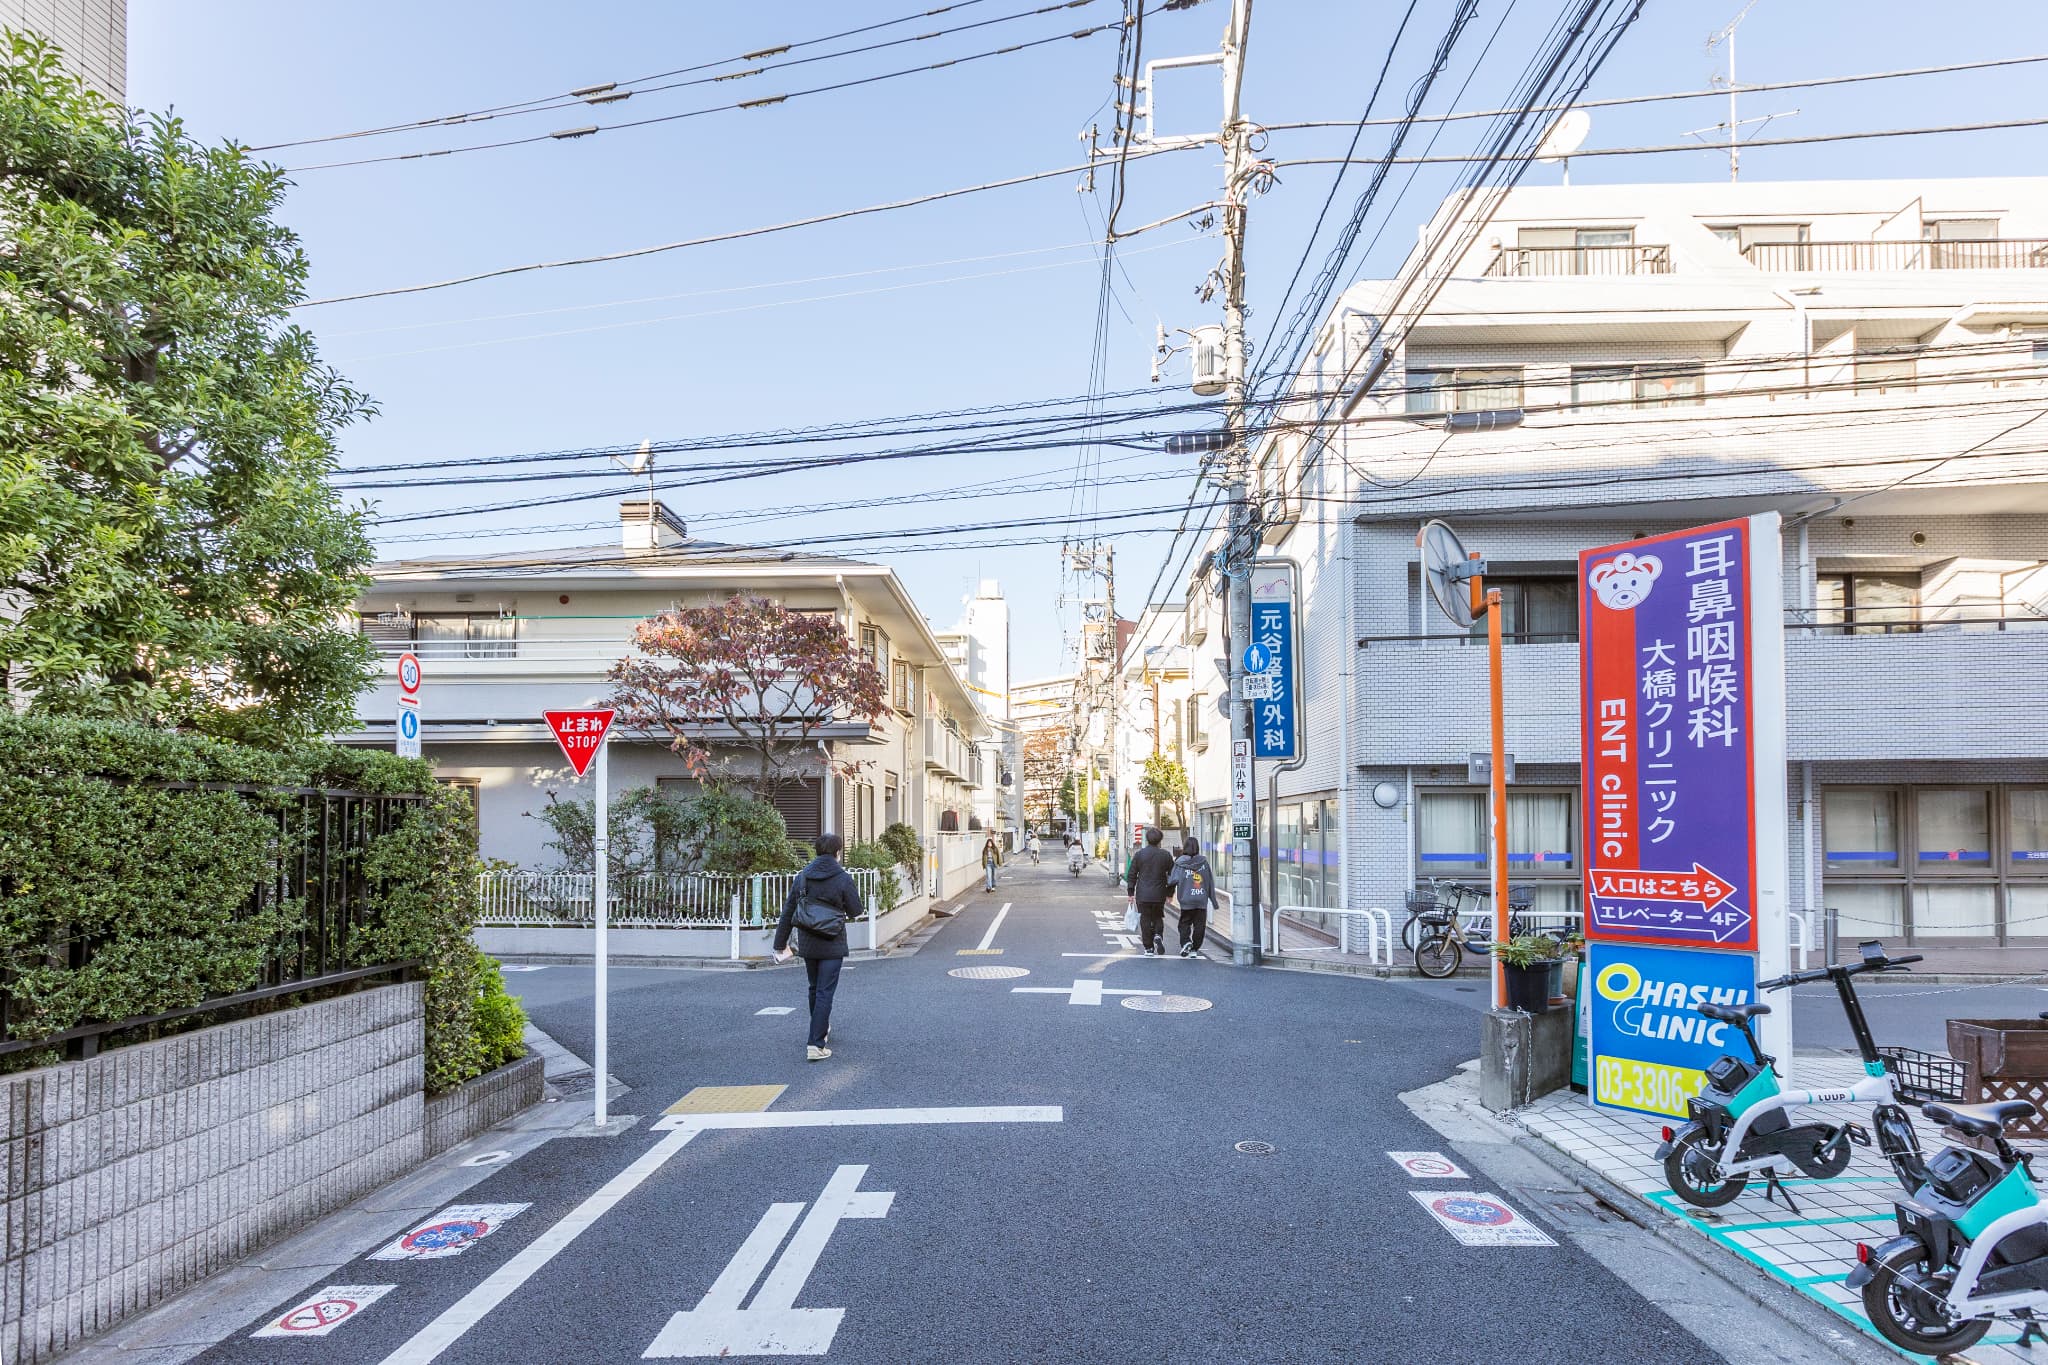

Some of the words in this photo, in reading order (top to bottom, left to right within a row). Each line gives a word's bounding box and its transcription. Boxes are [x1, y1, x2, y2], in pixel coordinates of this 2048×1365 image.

[1685, 534, 1738, 748] 耳鼻咽喉科
[403, 664, 417, 684] 30
[559, 716, 603, 733] 止まれ
[1600, 698, 1627, 762] ENT
[567, 736, 597, 748] STOP
[1642, 638, 1677, 844] 大橋クリニック
[1235, 769, 1247, 790] 小林
[1601, 774, 1627, 857] clinic
[1599, 876, 1722, 898] 入口はこちら
[1600, 906, 1704, 924] エレベーター
[1709, 912, 1739, 926] 4F
[1596, 962, 1748, 1010] OHASHI
[1612, 997, 1729, 1048] CLINIC
[1818, 1093, 1846, 1102] LUUP
